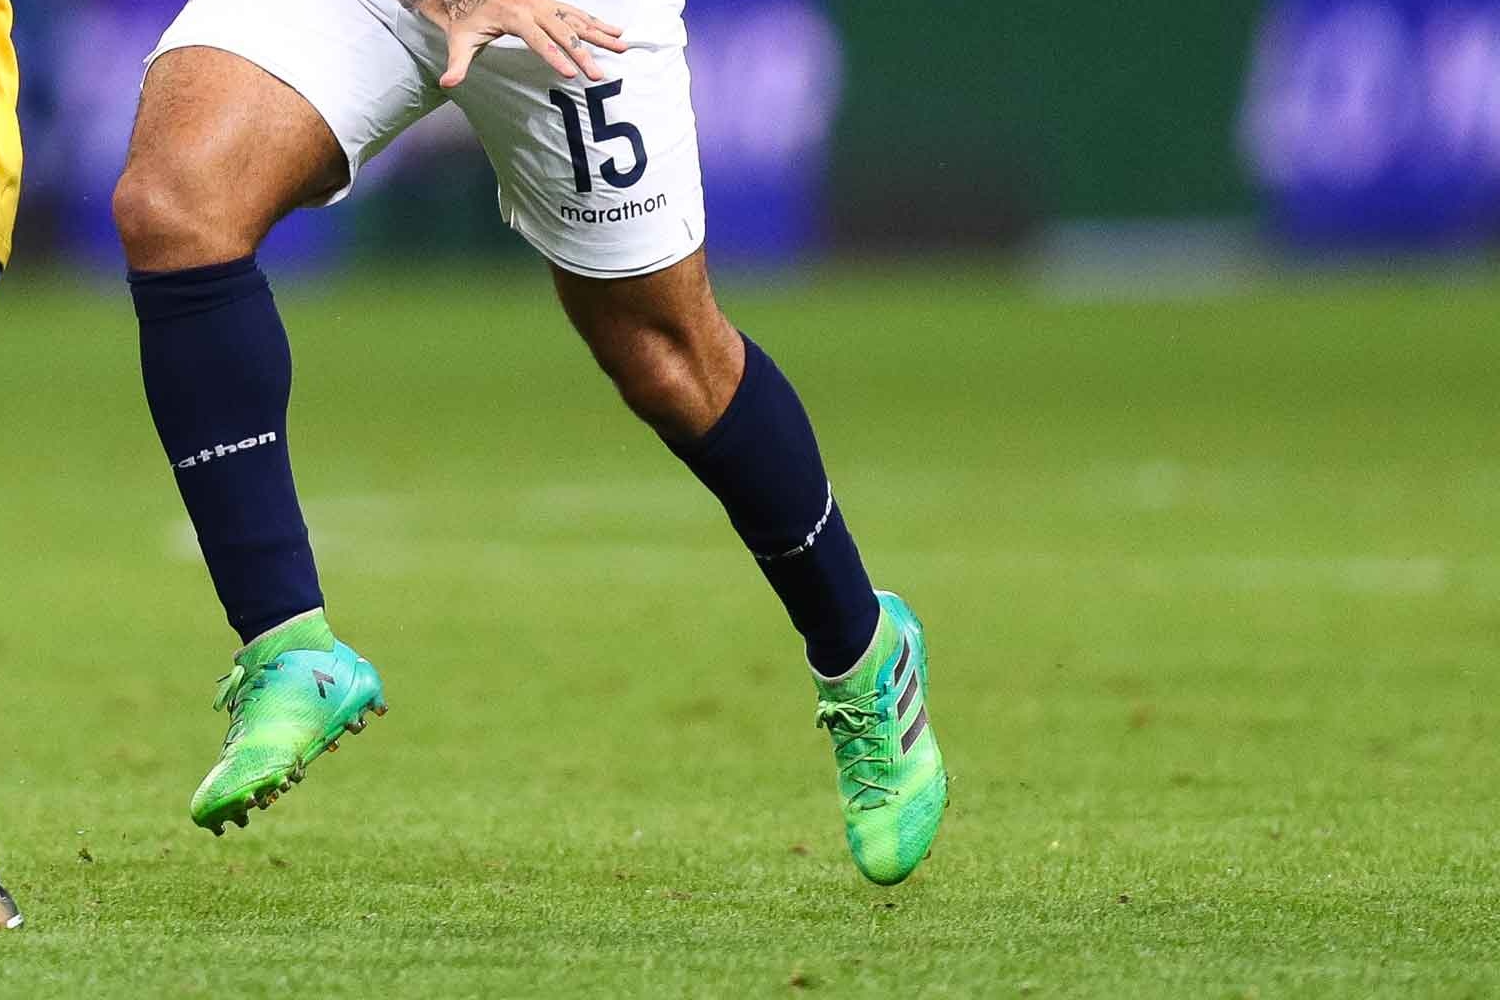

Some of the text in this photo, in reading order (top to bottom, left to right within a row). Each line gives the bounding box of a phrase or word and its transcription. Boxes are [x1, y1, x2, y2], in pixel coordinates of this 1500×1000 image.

[549, 78, 648, 193] 15
[561, 193, 667, 223] marathon
[171, 431, 277, 468] athon
